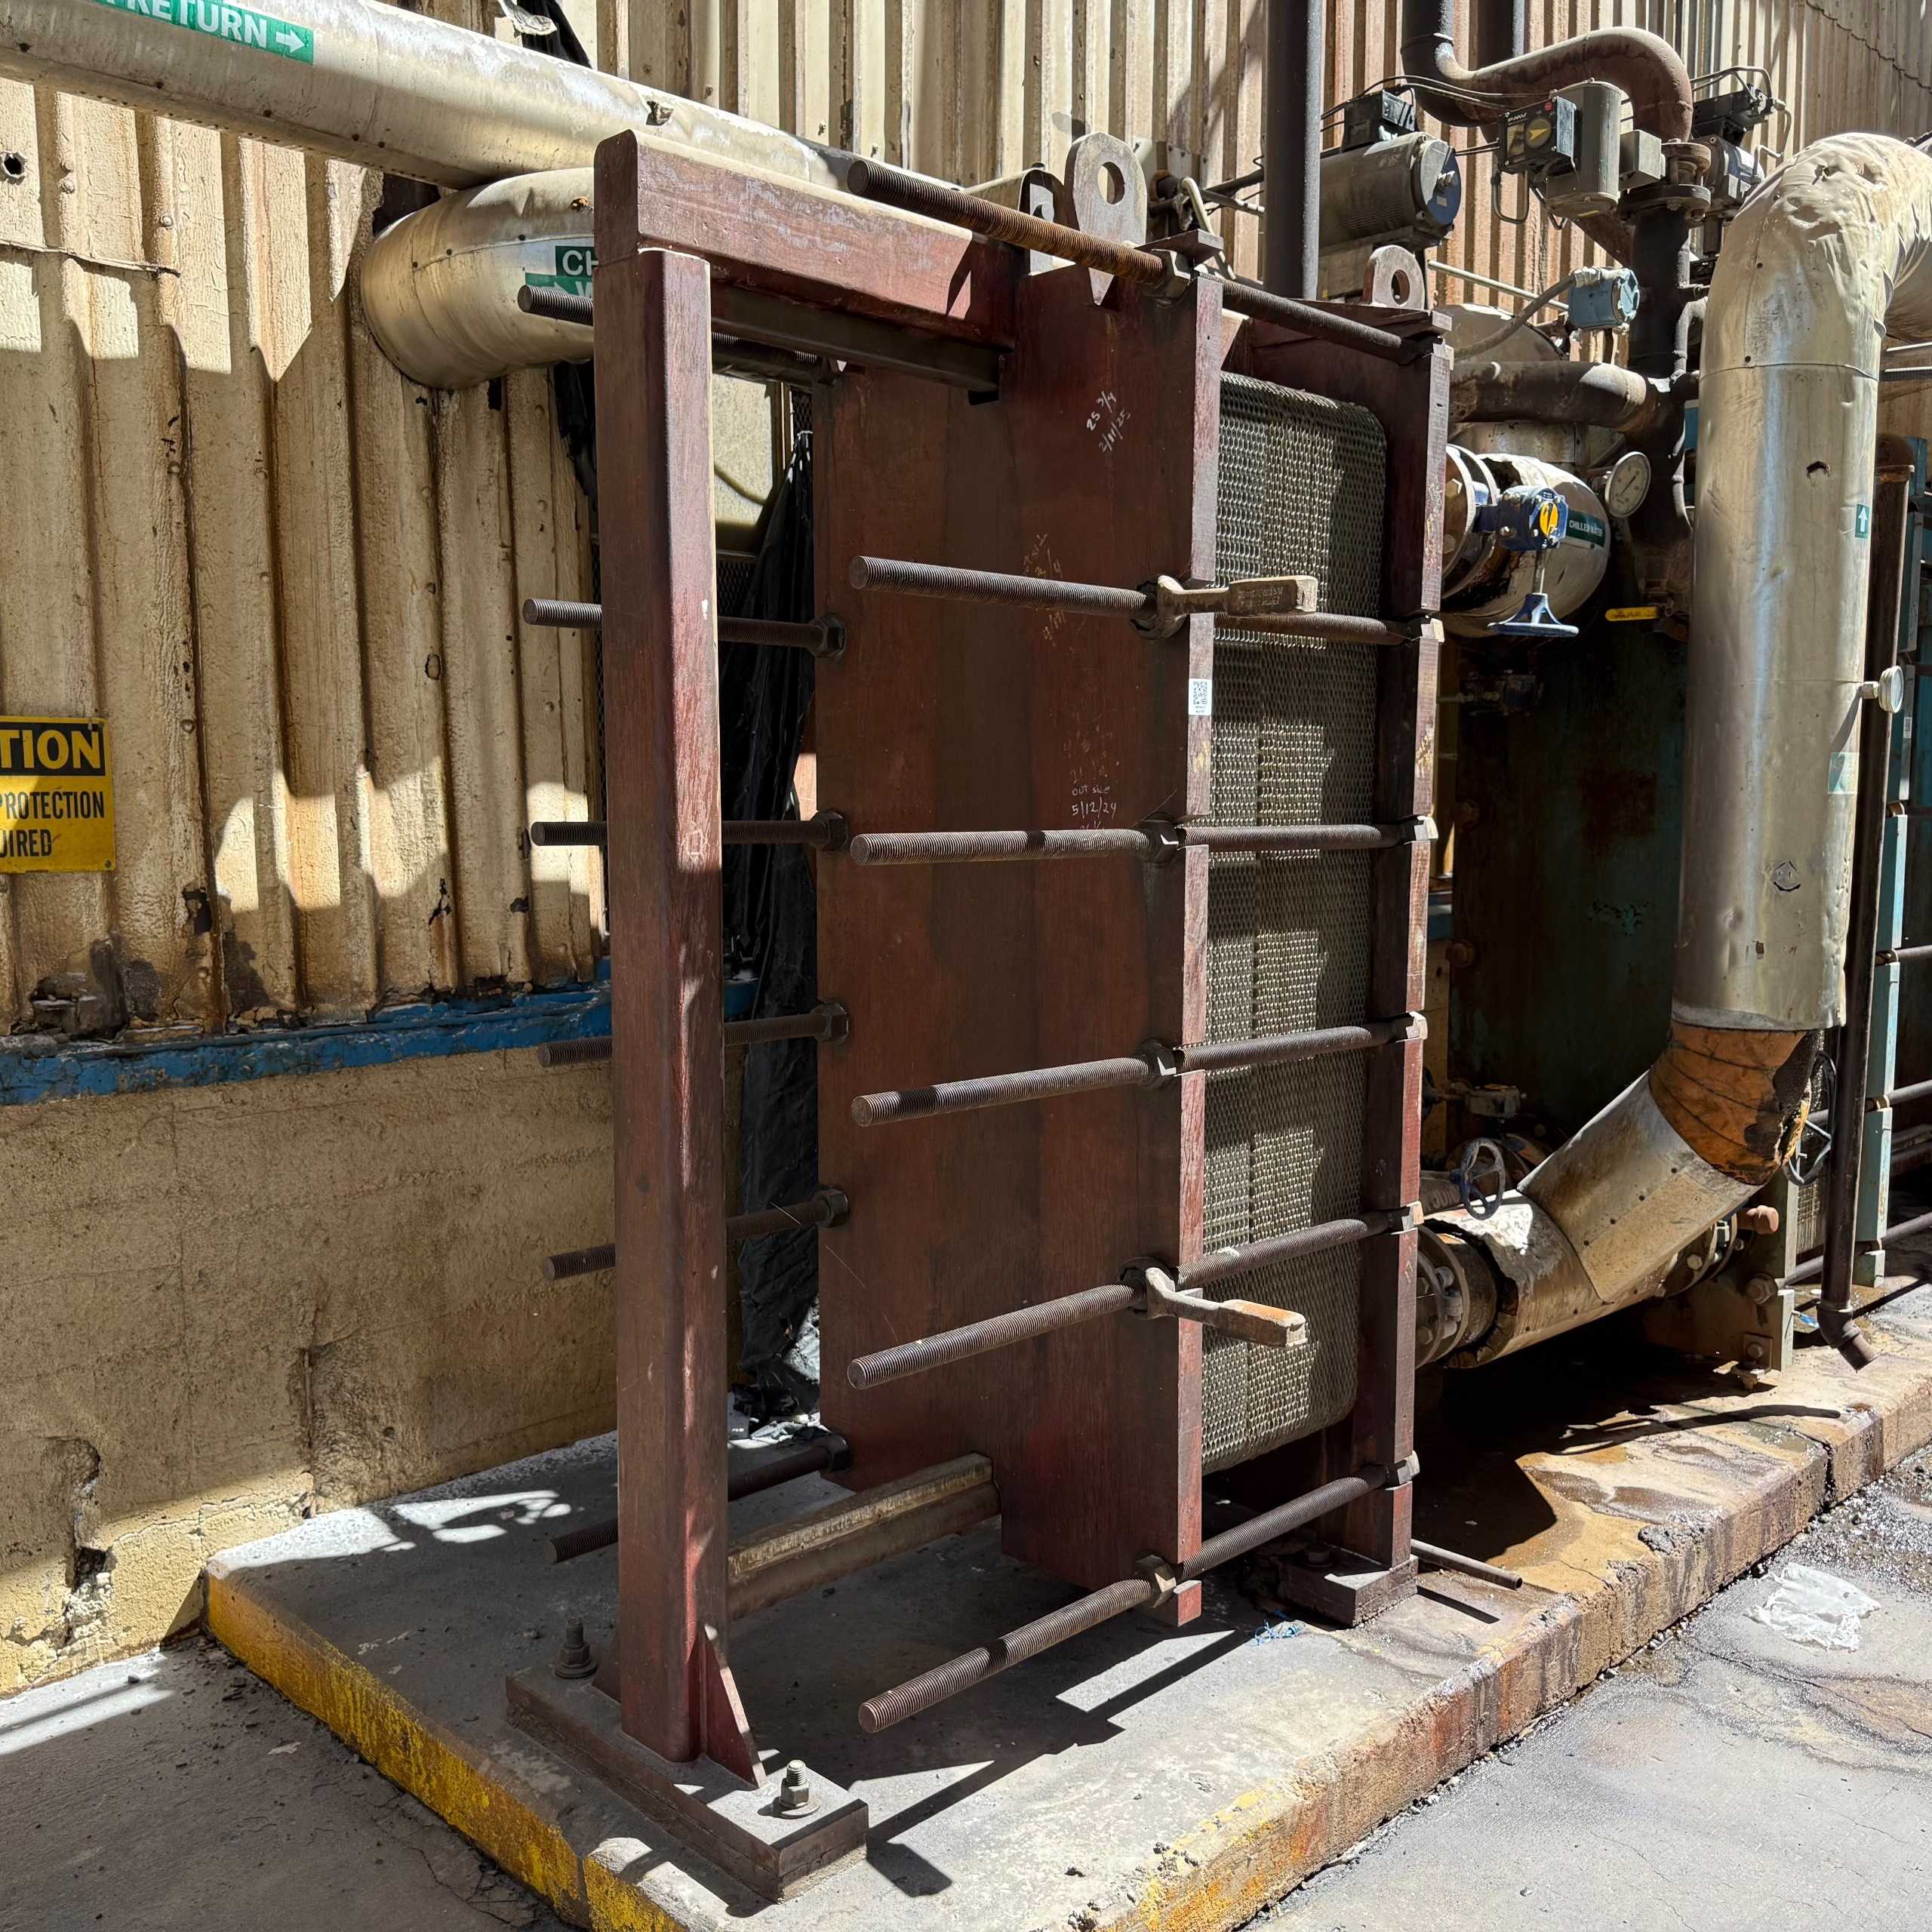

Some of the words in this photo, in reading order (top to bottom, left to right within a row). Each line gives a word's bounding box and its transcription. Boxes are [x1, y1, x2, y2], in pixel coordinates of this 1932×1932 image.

[1087, 411, 1101, 431] 25
[0, 729, 101, 770] TION
[1072, 784, 1088, 796] out
[0, 791, 105, 820] ROTECTION
[1072, 796, 1117, 820] 5/12/24
